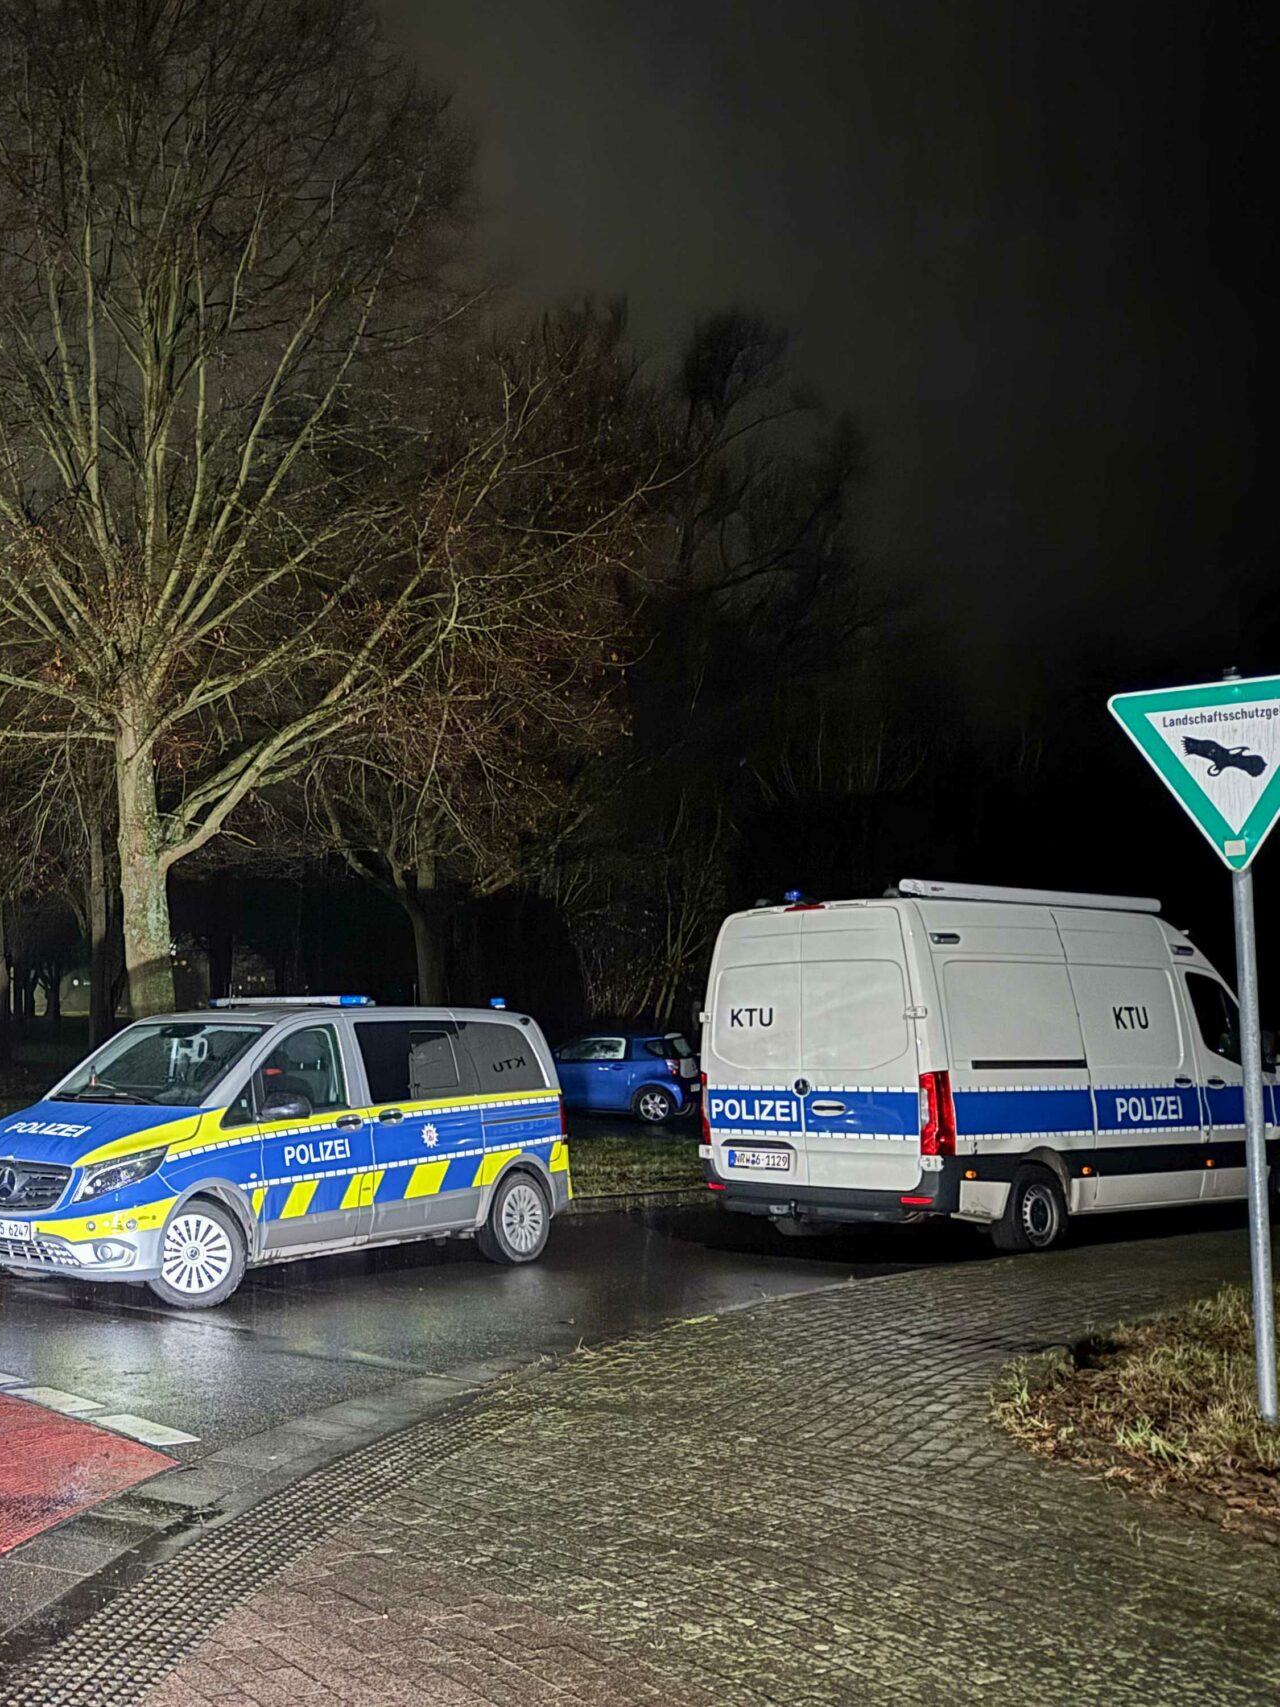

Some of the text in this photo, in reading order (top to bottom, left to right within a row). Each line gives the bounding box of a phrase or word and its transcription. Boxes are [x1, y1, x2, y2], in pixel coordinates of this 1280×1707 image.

[1162, 706, 1280, 728] Landschaftsschutzge
[730, 1007, 773, 1027] KTU
[1111, 1006, 1149, 1030] KTU
[711, 1098, 798, 1122] POLIZEI
[1115, 1096, 1183, 1122] POLIZEI
[4, 1121, 92, 1138] POLIZEI
[283, 1138, 351, 1167] POLIZEI
